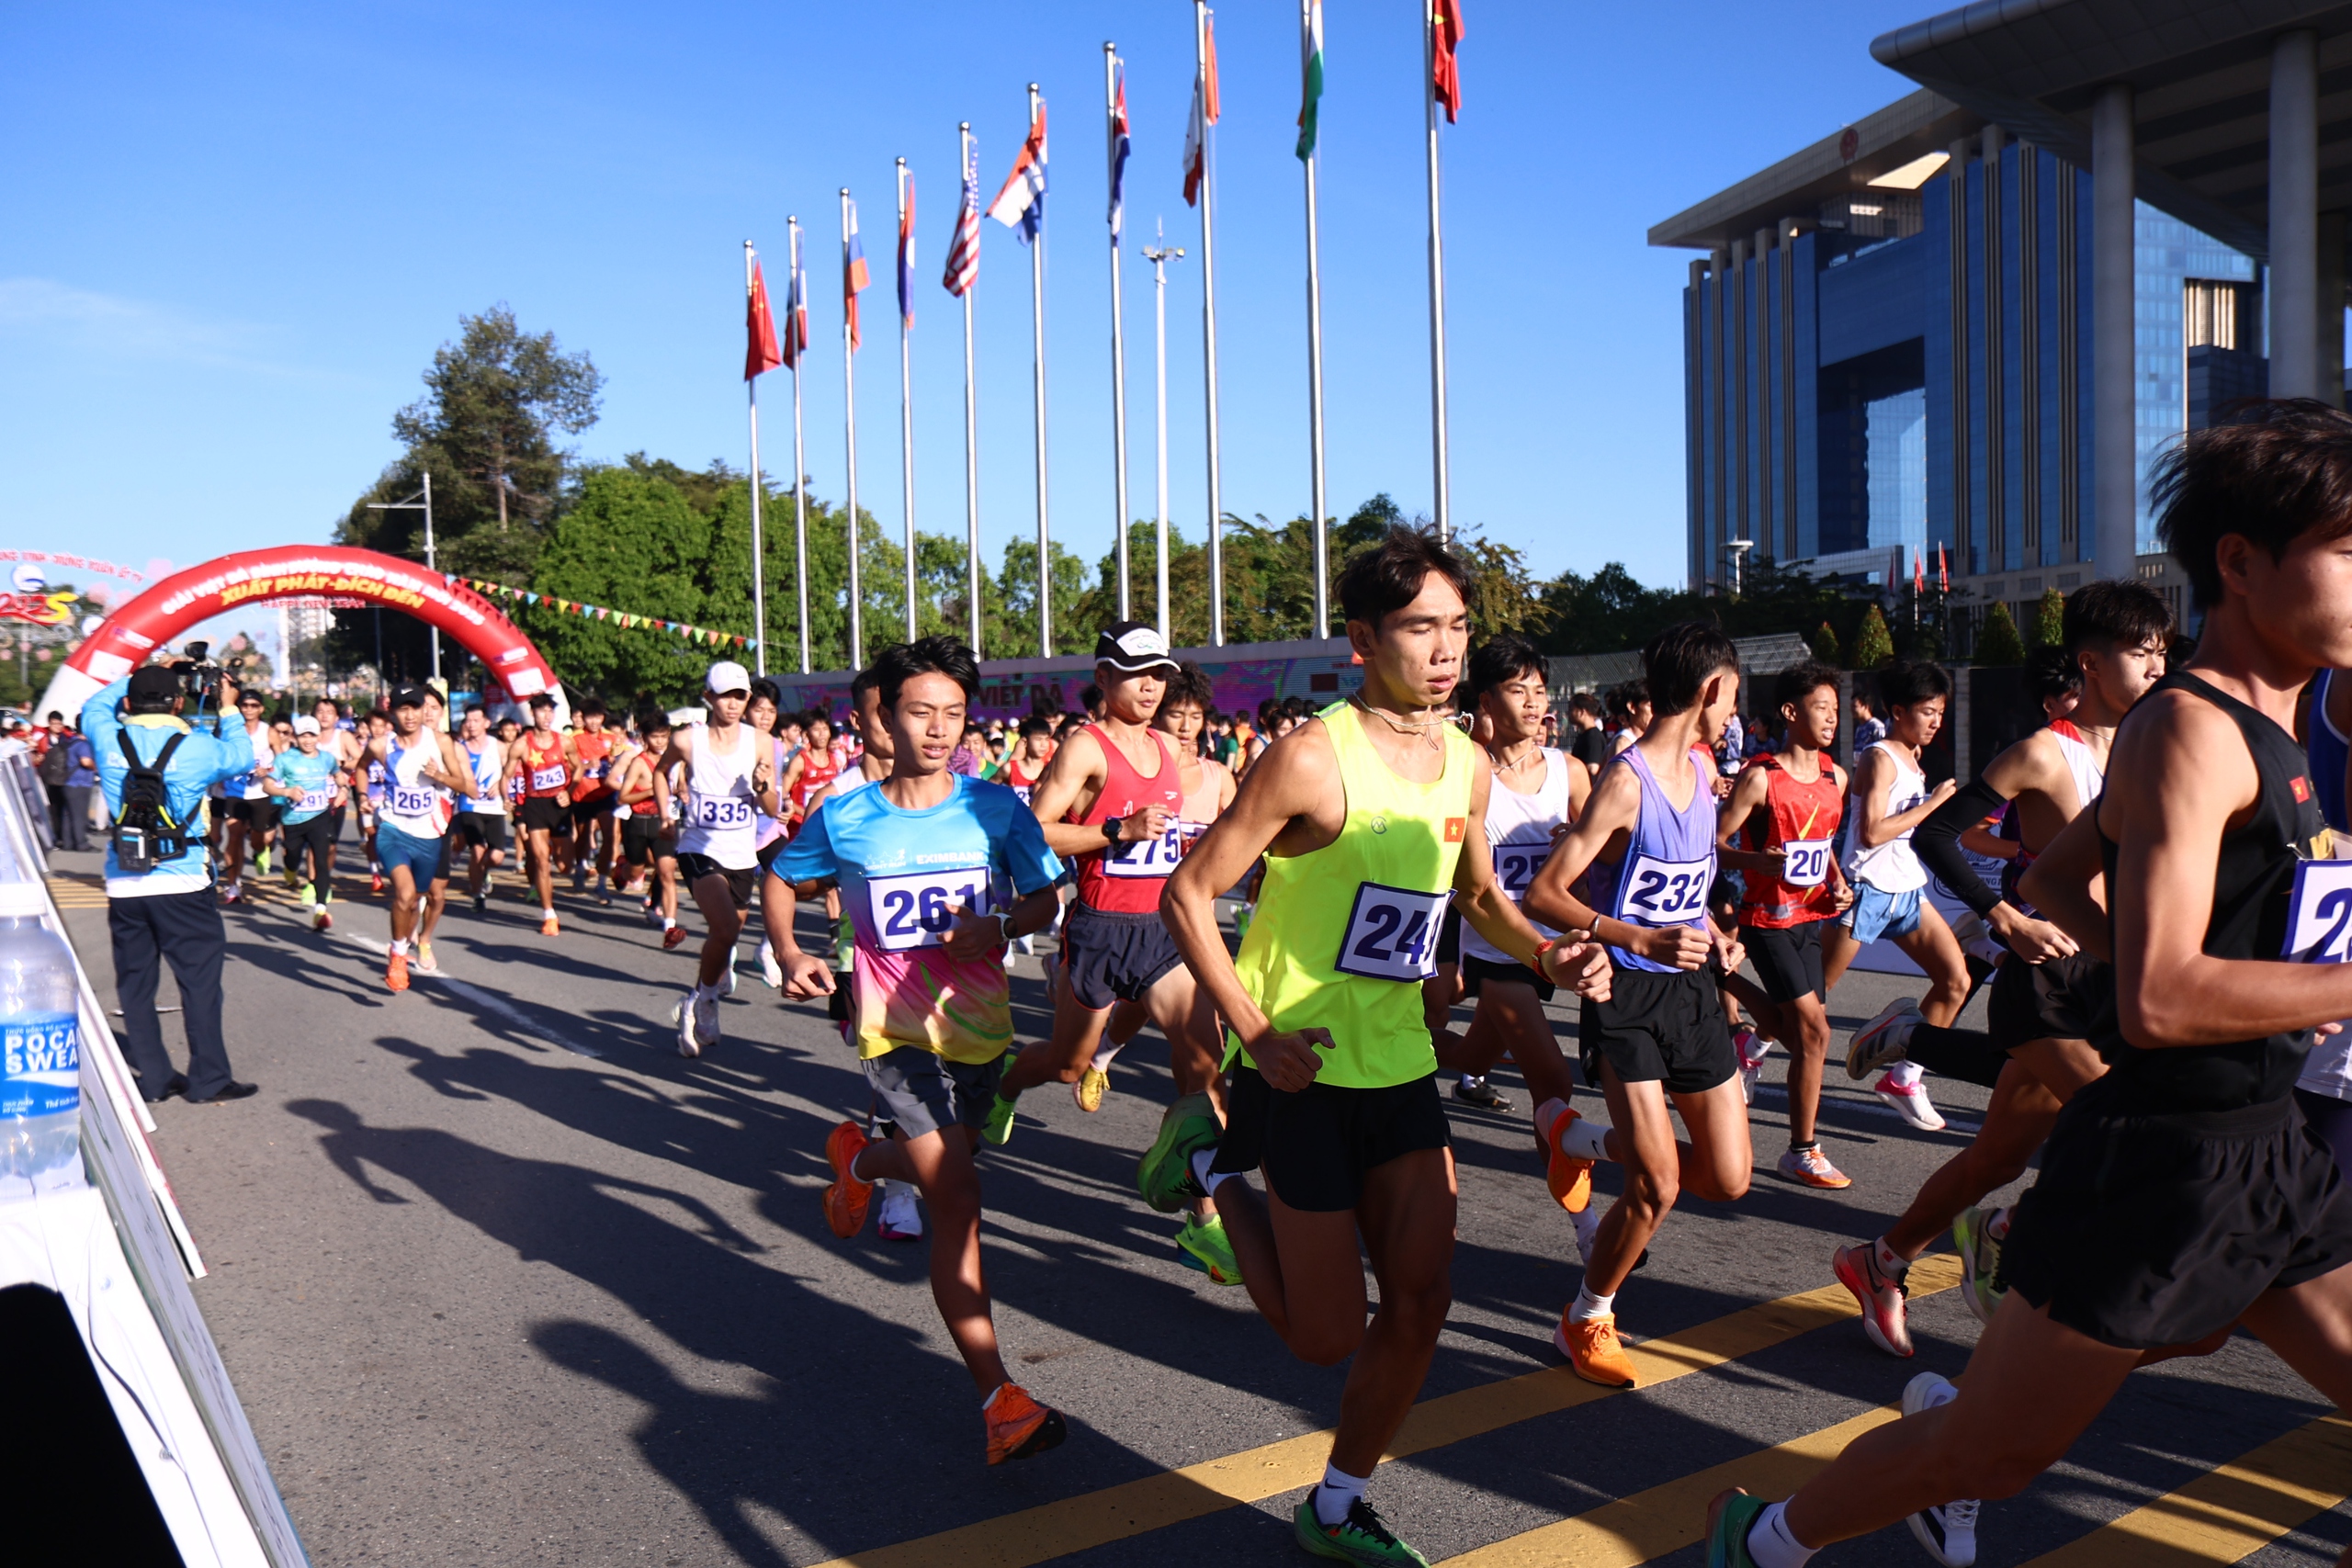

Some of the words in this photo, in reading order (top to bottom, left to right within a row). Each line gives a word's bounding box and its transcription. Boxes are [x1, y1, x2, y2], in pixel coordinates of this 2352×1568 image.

[535, 770, 564, 788] 243
[397, 791, 433, 810] 265
[703, 800, 749, 824] 335
[916, 851, 985, 865] EXIMBANK
[1630, 870, 1706, 912] 232
[883, 884, 977, 937] 261
